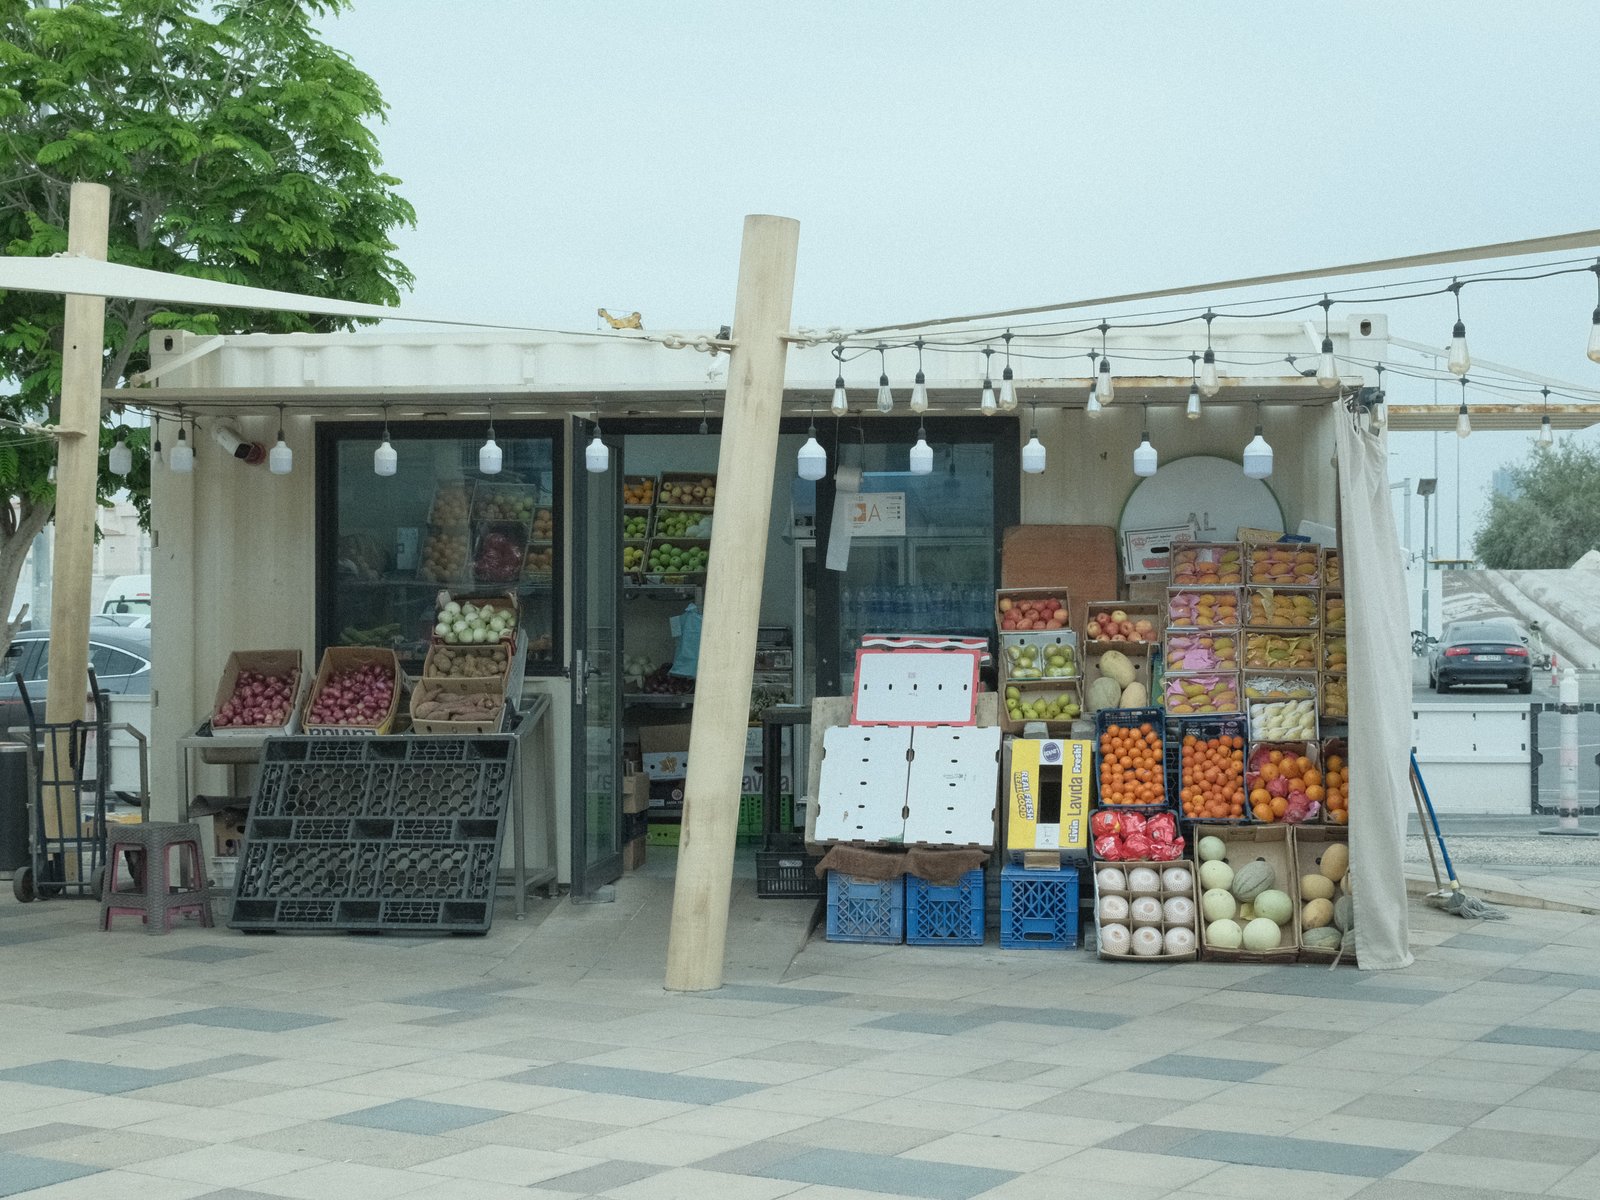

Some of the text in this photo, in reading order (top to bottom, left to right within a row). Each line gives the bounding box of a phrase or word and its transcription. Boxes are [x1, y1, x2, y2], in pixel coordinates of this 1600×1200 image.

[1014, 771, 1026, 818] REAL GOOD
[1021, 770, 1034, 820] REAL FRESH
[1067, 744, 1083, 843] Livin Lavida Fresh!
